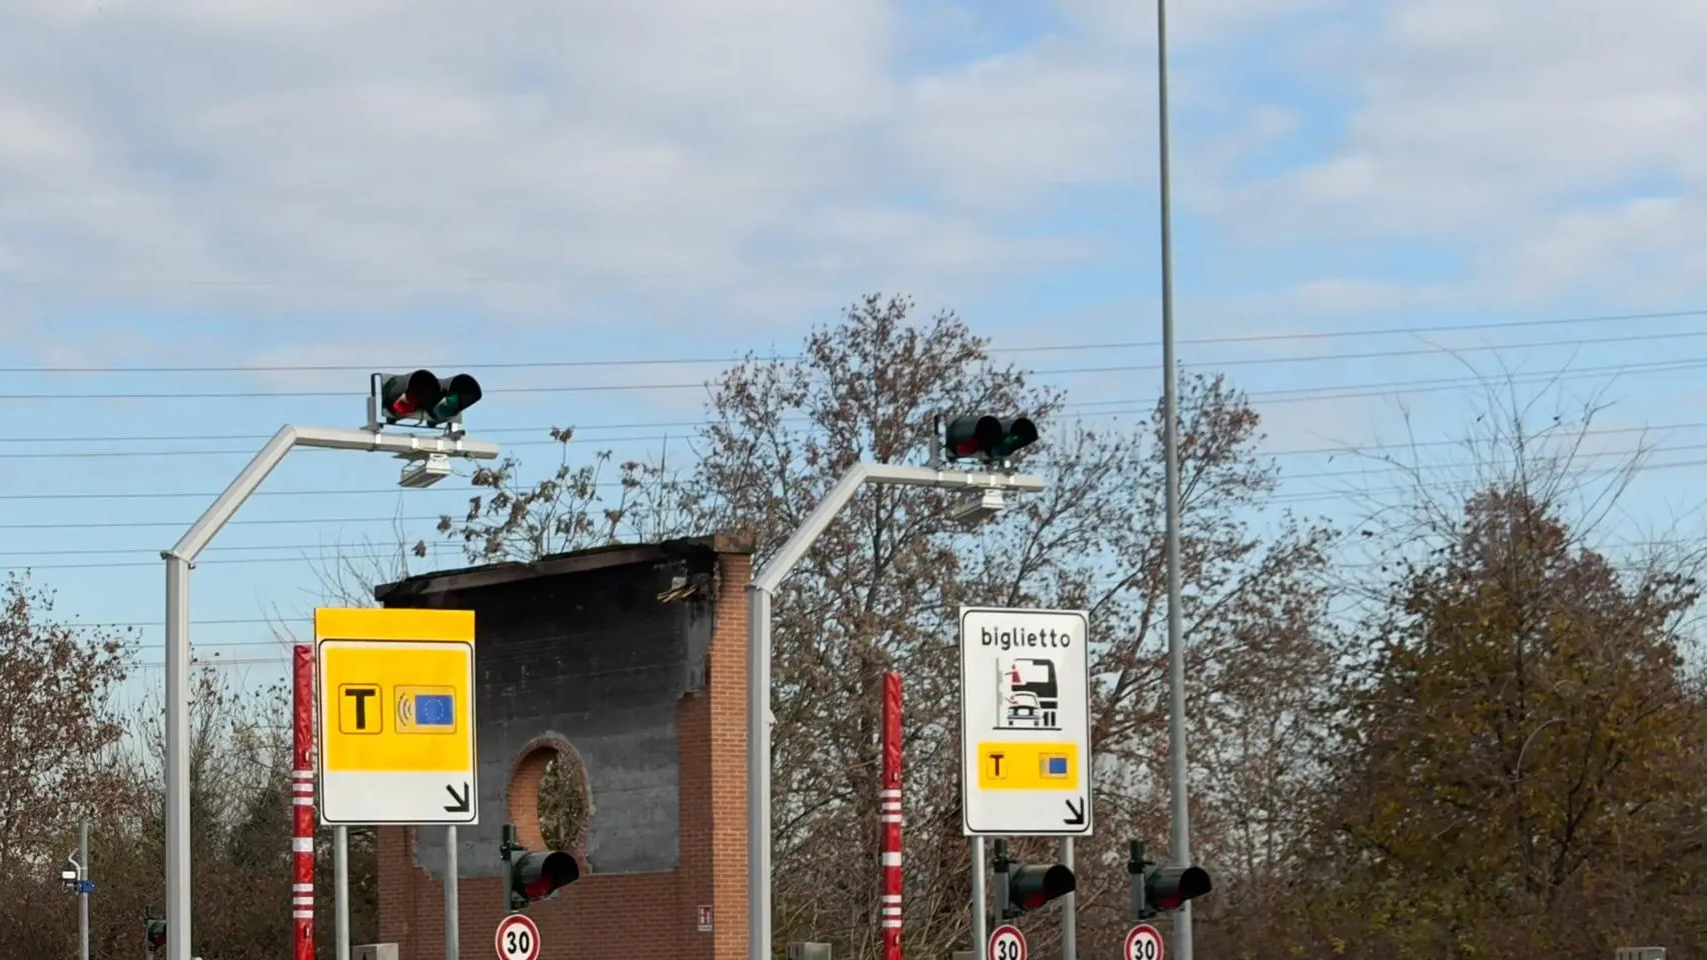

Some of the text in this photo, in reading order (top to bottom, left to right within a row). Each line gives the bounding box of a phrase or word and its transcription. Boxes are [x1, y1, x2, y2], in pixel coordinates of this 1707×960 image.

[981, 626, 1071, 651] biglietto
[345, 688, 376, 730] T
[989, 753, 1005, 777] T
[507, 931, 530, 954] 30
[1134, 939, 1155, 960] 30
